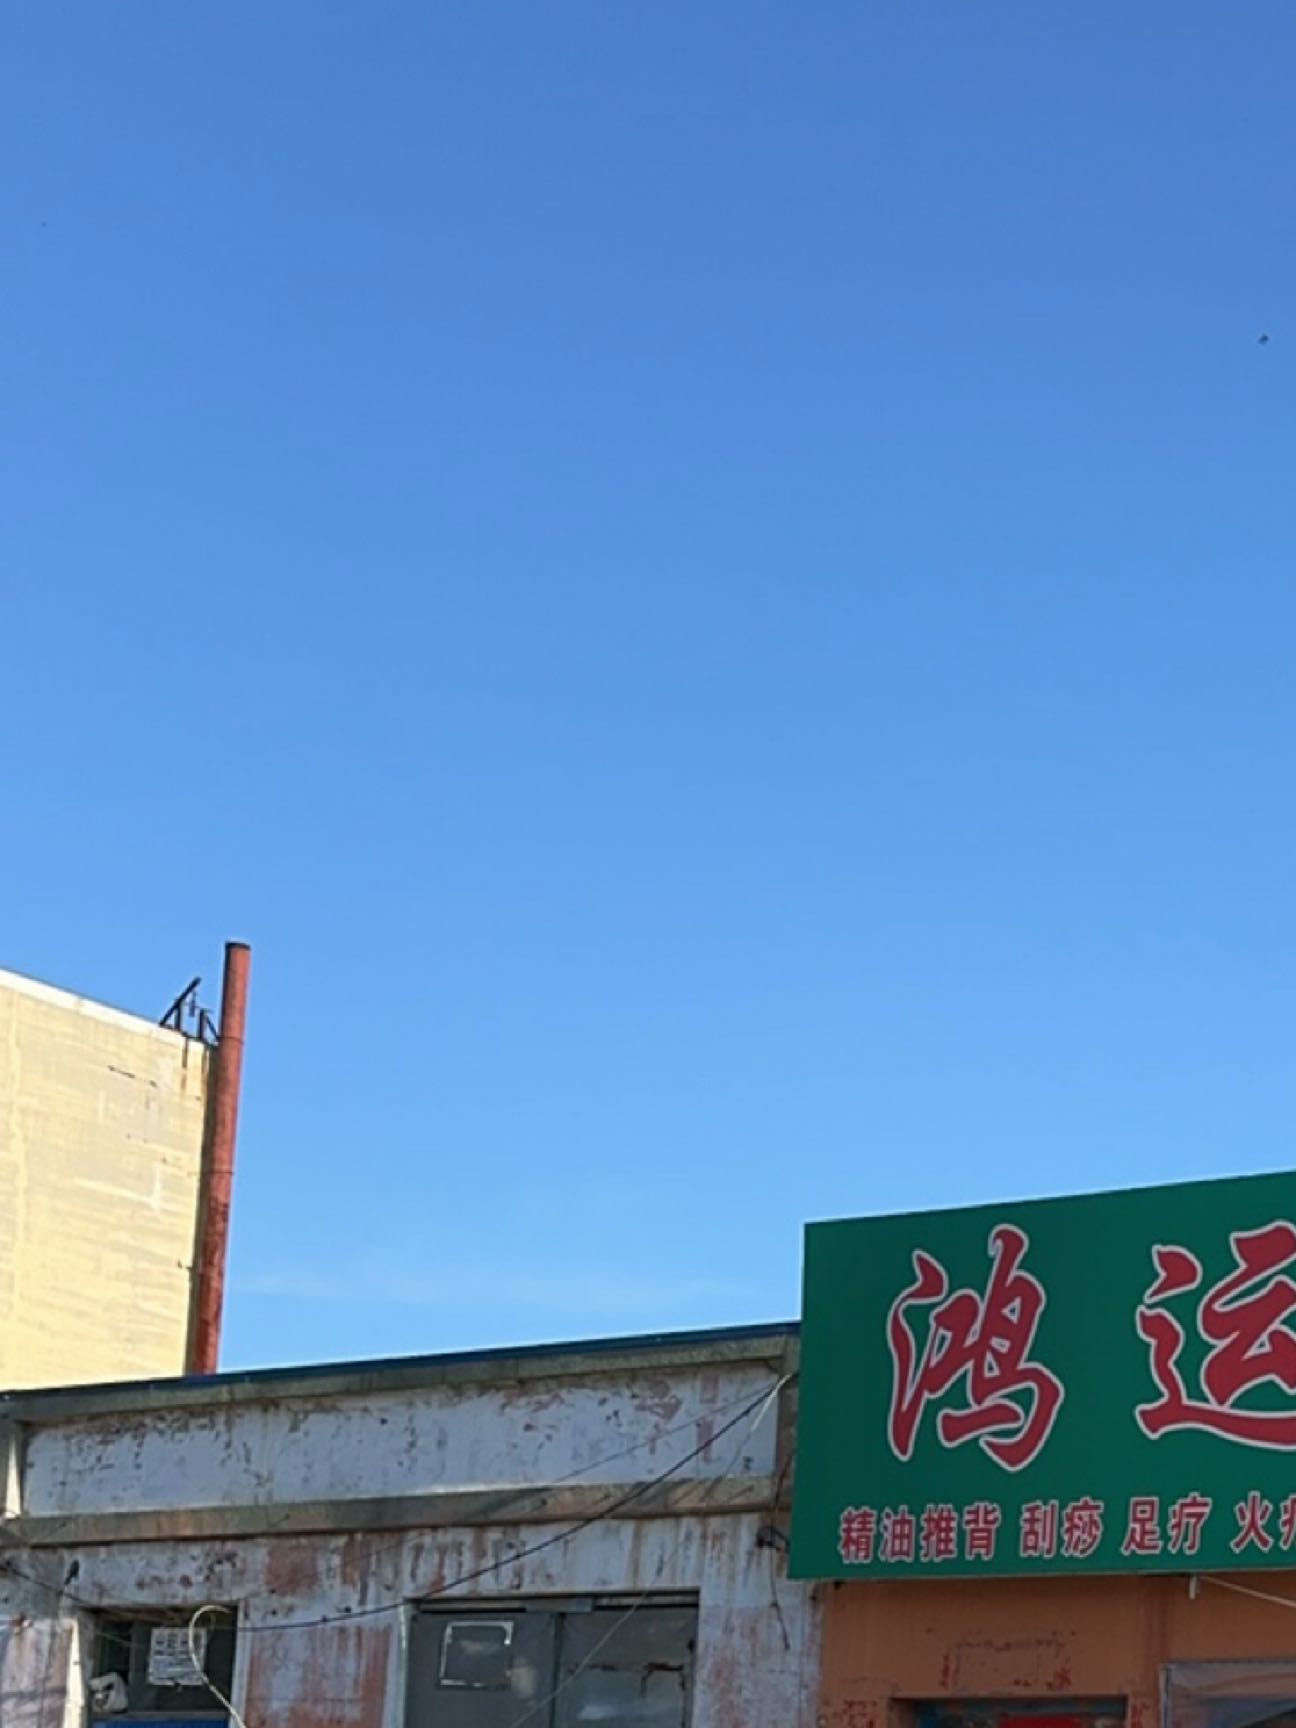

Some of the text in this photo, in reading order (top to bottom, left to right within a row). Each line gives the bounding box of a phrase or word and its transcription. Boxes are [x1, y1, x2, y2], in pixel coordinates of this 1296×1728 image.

[838, 1503, 1002, 1564] 精油推背
[1018, 1498, 1104, 1559] 刮痧
[1121, 1492, 1212, 1556] 足疗
